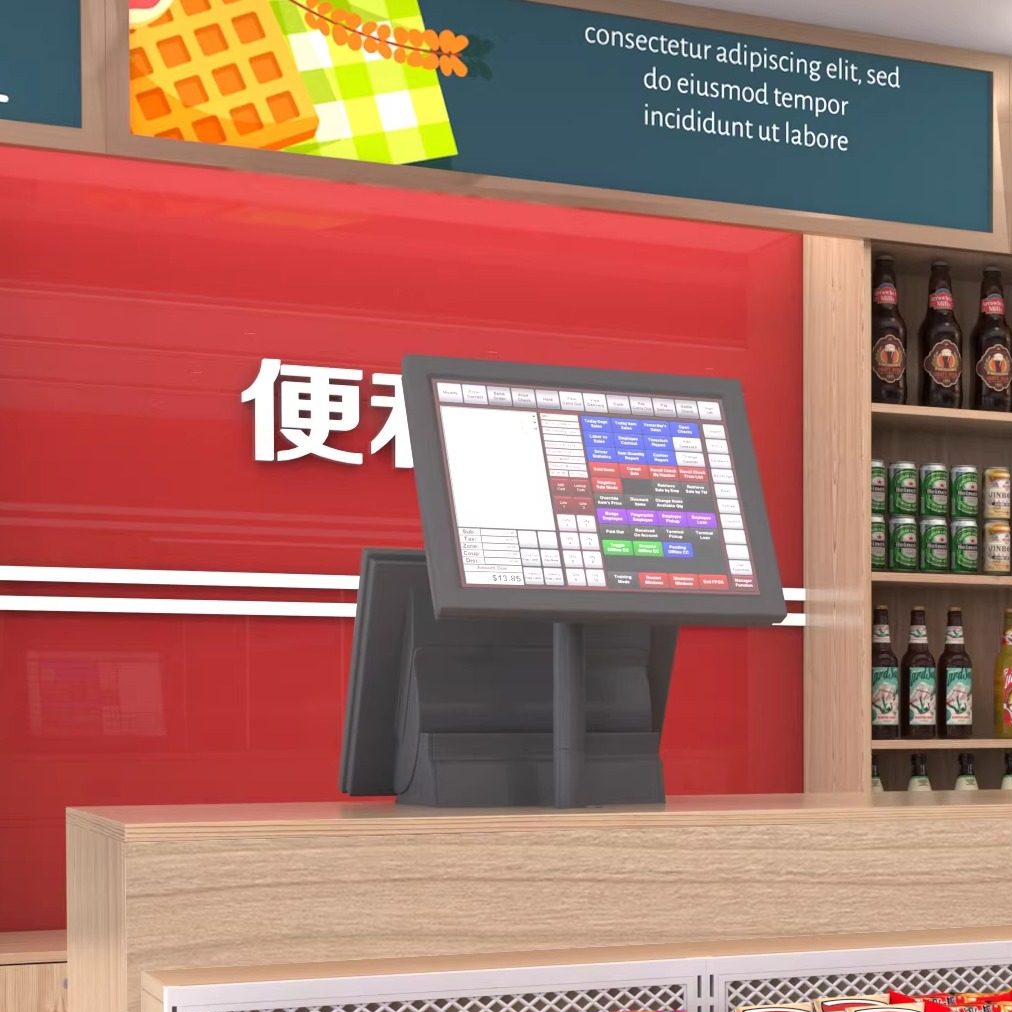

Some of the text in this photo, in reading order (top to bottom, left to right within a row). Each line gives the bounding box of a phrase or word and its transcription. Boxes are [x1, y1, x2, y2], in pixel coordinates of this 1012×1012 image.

[585, 26, 900, 88] consectetur adipiscing elit, sed
[643, 66, 849, 118] do eiusmod tempor
[643, 103, 849, 152] incididunt ut labore
